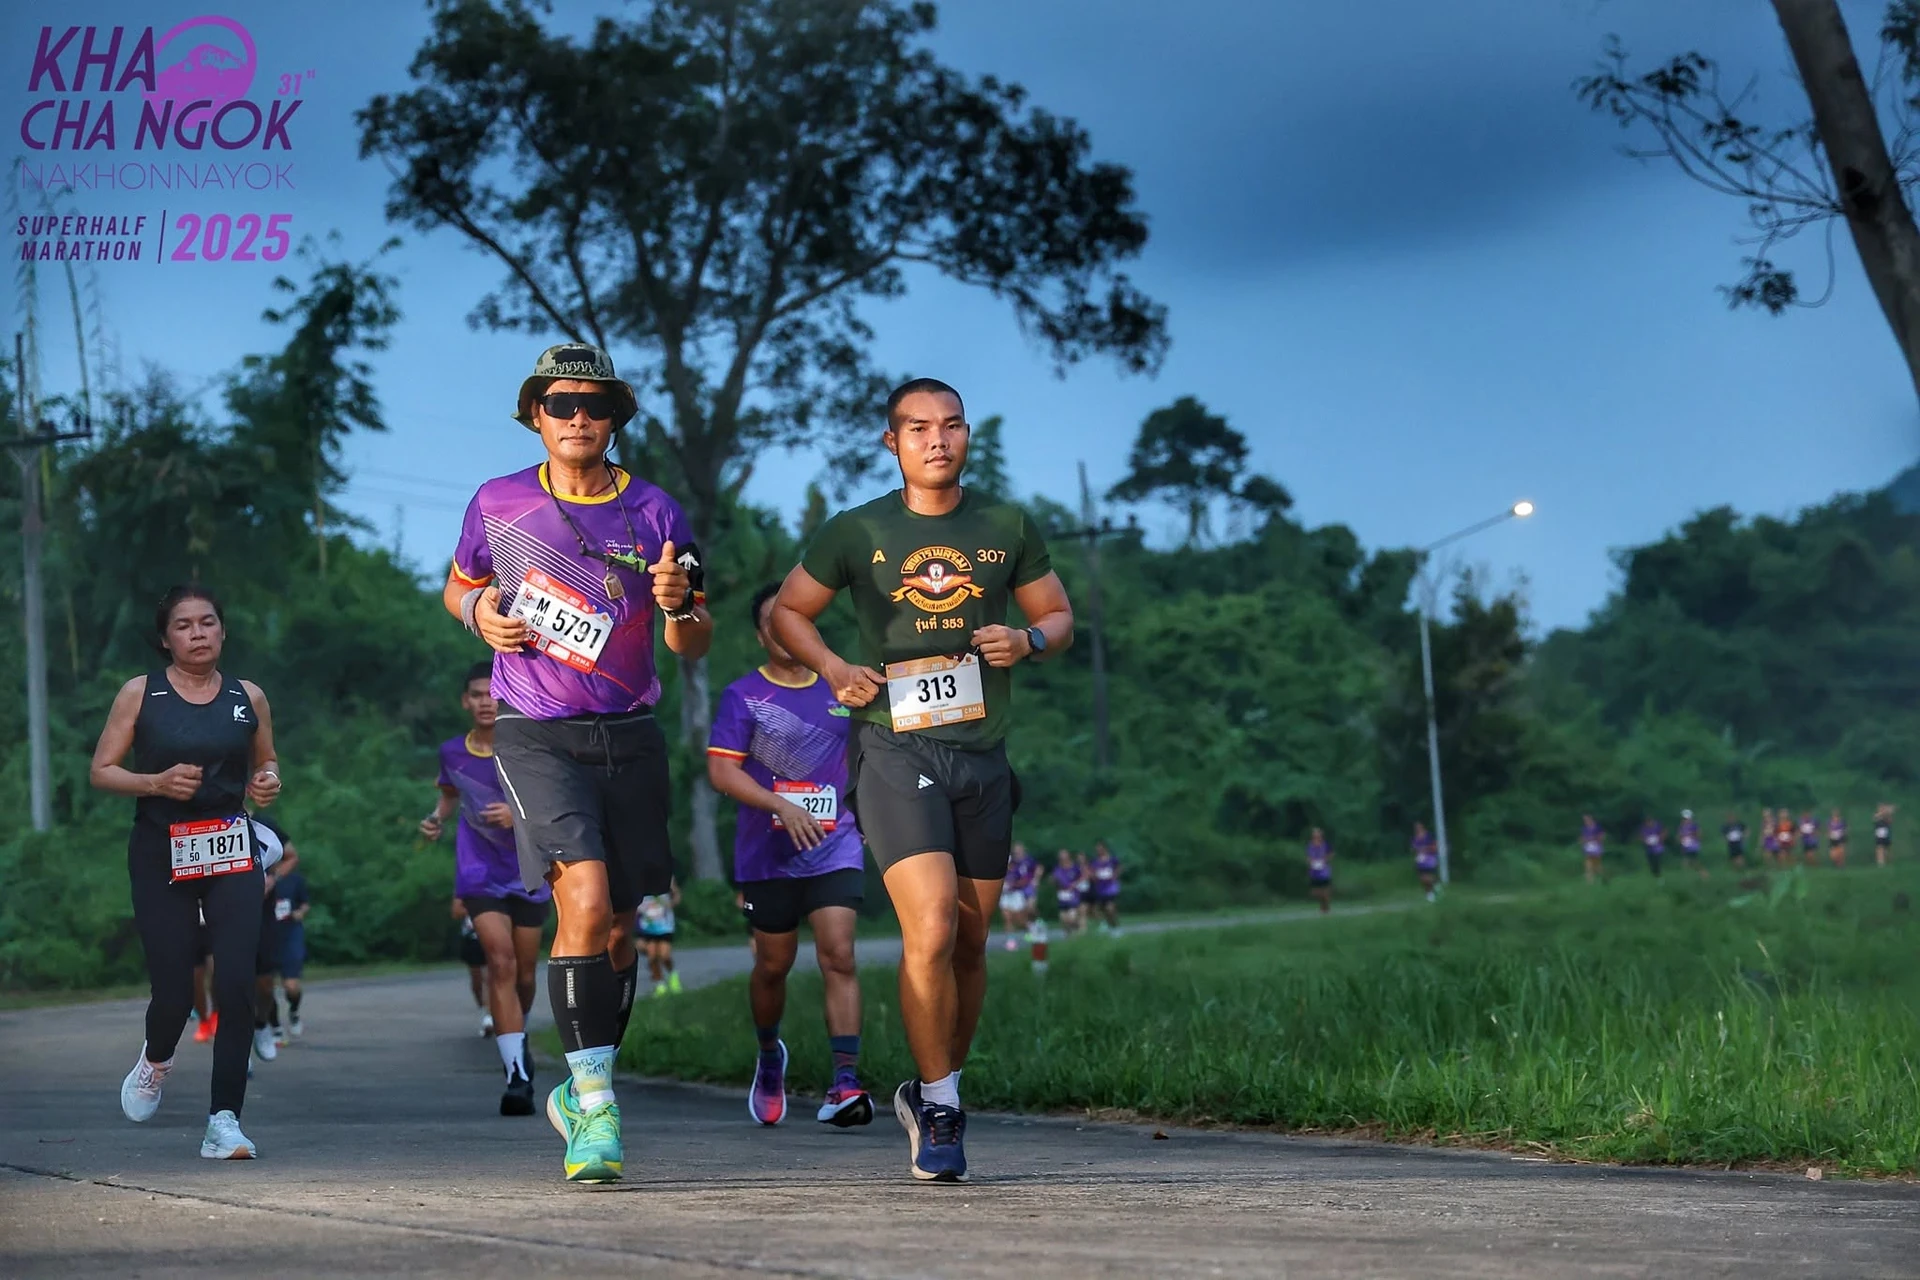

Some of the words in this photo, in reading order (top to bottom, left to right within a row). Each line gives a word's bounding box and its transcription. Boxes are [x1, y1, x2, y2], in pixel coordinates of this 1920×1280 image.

[872, 550, 886, 564] A
[977, 550, 1006, 564] 307
[530, 614, 544, 627] 40
[536, 597, 551, 614] M
[552, 608, 602, 649] 5791
[915, 614, 938, 634] รุ่นที่
[942, 617, 964, 629] 353
[571, 654, 590, 668] CRMA
[917, 675, 957, 703] 313
[964, 705, 982, 714] CRMA
[802, 797, 833, 813] 3277
[174, 840, 184, 849] 16
[190, 838, 197, 851] F
[207, 832, 244, 856] 1871
[189, 851, 200, 863] 50
